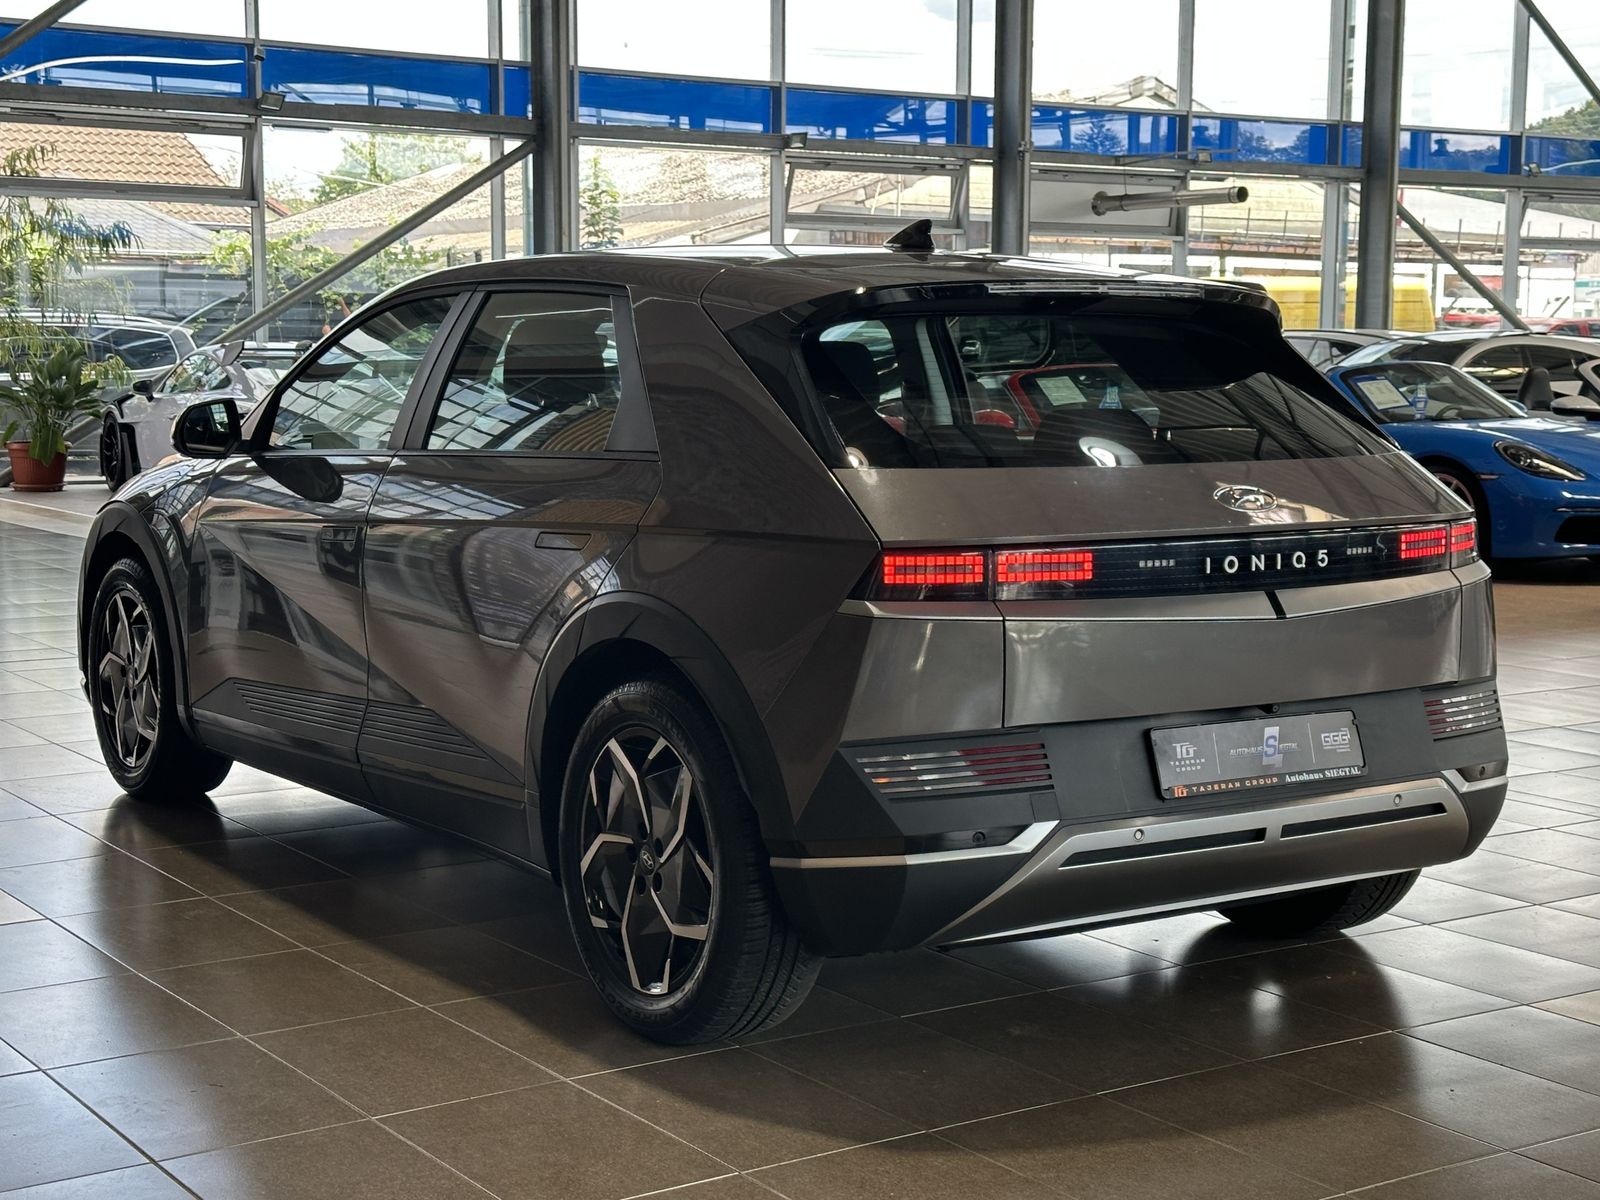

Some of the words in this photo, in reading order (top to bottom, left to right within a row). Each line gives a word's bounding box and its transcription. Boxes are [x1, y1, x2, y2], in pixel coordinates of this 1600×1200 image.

[1206, 551, 1306, 574] IONIQ
[1317, 549, 1329, 568] 5
[1169, 759, 1205, 767] TAJERAN
[1176, 765, 1201, 773] GROUP
[1285, 772, 1324, 783] Autohaus
[1324, 766, 1361, 778] SIEGTAL
[1191, 781, 1241, 793] TAJERAN
[1245, 777, 1278, 787] GROUP
